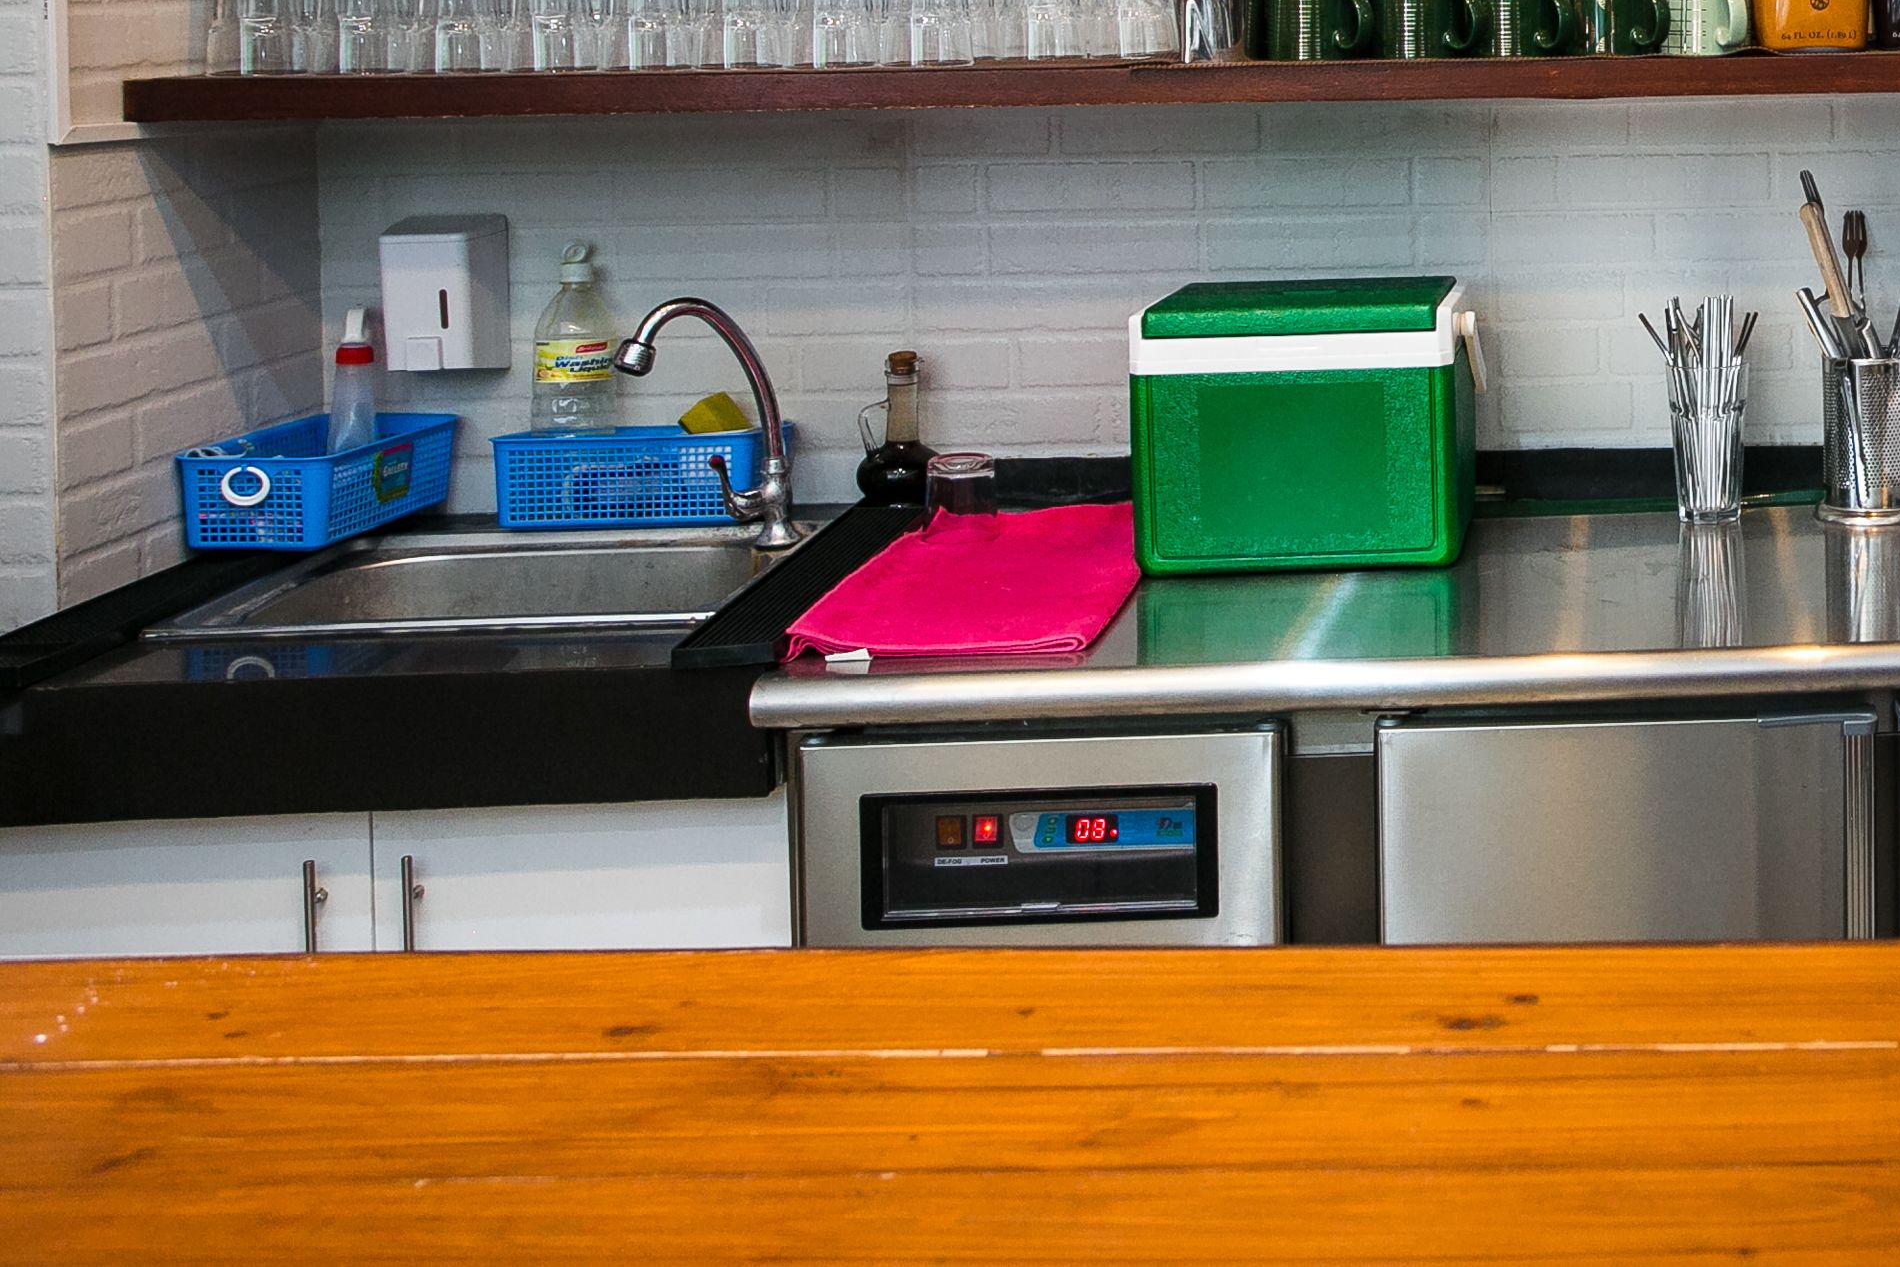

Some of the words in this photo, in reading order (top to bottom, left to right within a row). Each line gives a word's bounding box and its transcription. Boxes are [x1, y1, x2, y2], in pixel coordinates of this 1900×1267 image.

[1781, 31, 1792, 40] 64
[1794, 30, 1806, 39] FL.
[1808, 30, 1824, 39] OZ.
[1826, 29, 1848, 40] (1.89
[555, 357, 613, 367] Washin
